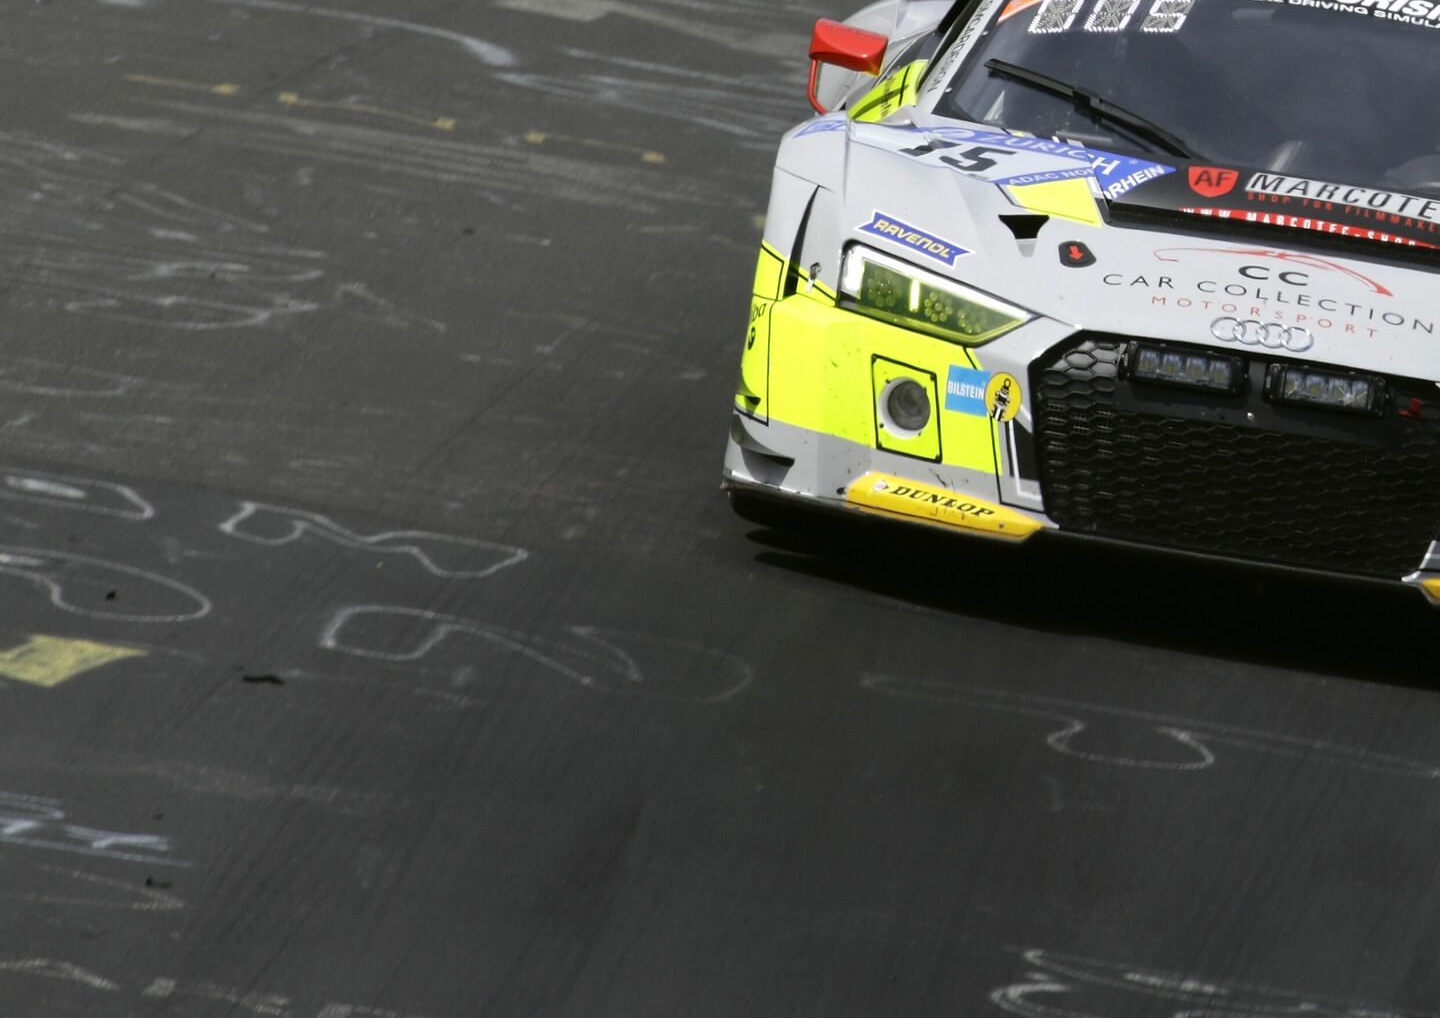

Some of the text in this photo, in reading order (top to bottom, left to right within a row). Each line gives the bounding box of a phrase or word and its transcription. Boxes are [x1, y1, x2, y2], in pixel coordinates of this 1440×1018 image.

[979, 134, 1121, 175] ZURICH
[1008, 172, 1059, 185] ADAC
[1194, 170, 1233, 187] AF
[1248, 191, 1291, 204] SHOP
[1303, 198, 1333, 211] FOR
[873, 218, 954, 259] RAVENOL
[1238, 265, 1309, 286] CC
[1103, 273, 1435, 335] CAR COLLECTION
[1152, 296, 1379, 338] MOTORSPORT
[947, 381, 985, 400] BILSTEIN
[892, 485, 995, 517] DUNLOP
